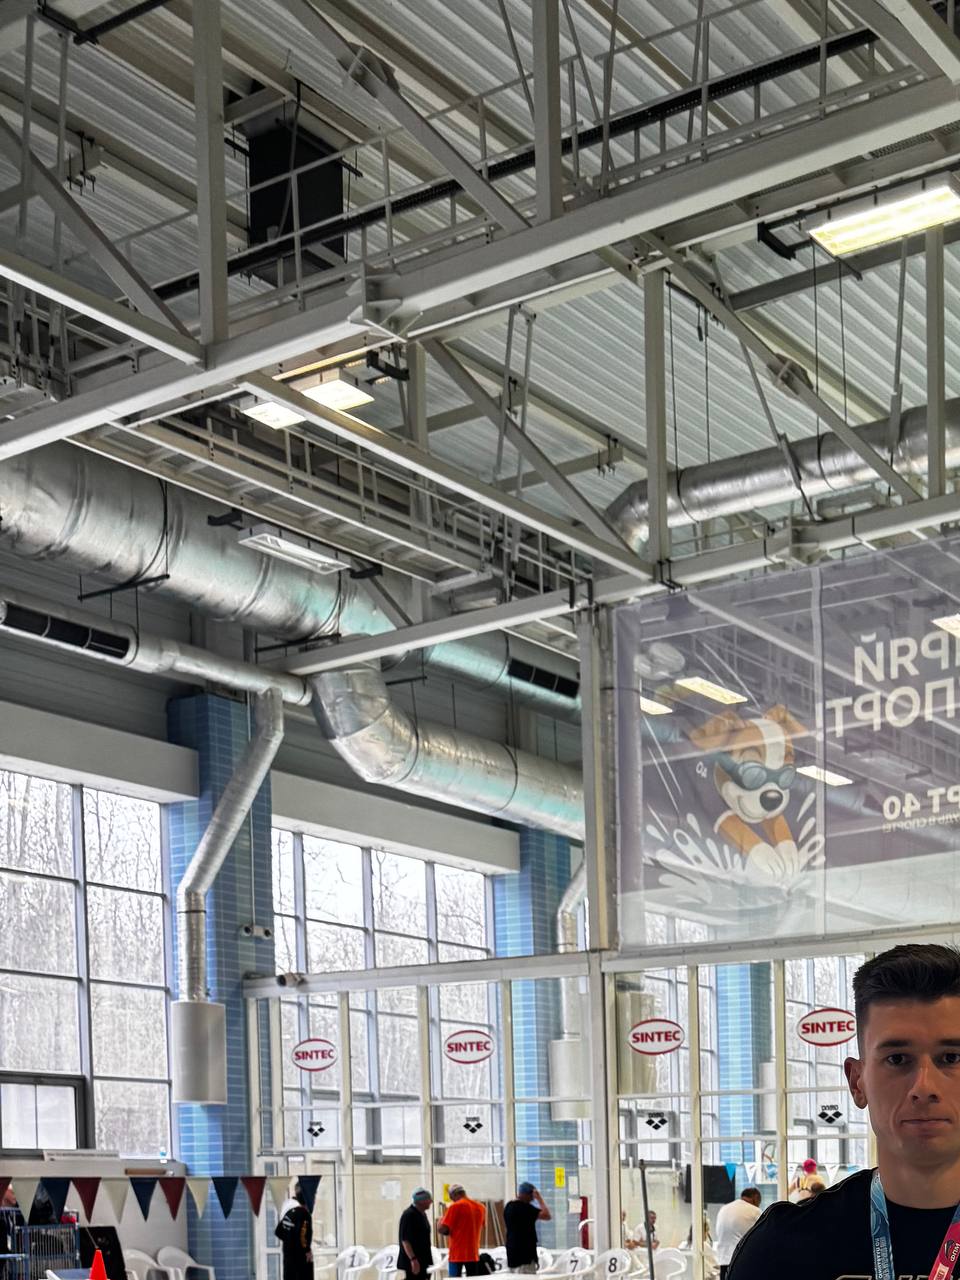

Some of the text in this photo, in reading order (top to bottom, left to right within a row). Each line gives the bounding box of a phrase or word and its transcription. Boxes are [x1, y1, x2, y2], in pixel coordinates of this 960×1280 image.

[801, 1020, 855, 1034] SINTEC
[631, 1030, 681, 1043] SINTEC
[447, 1041, 491, 1053] SINTEC
[294, 1049, 334, 1060] SINTEC
[385, 1255, 394, 1269] 2
[570, 1259, 578, 1273] 7
[608, 1257, 617, 1272] 8
